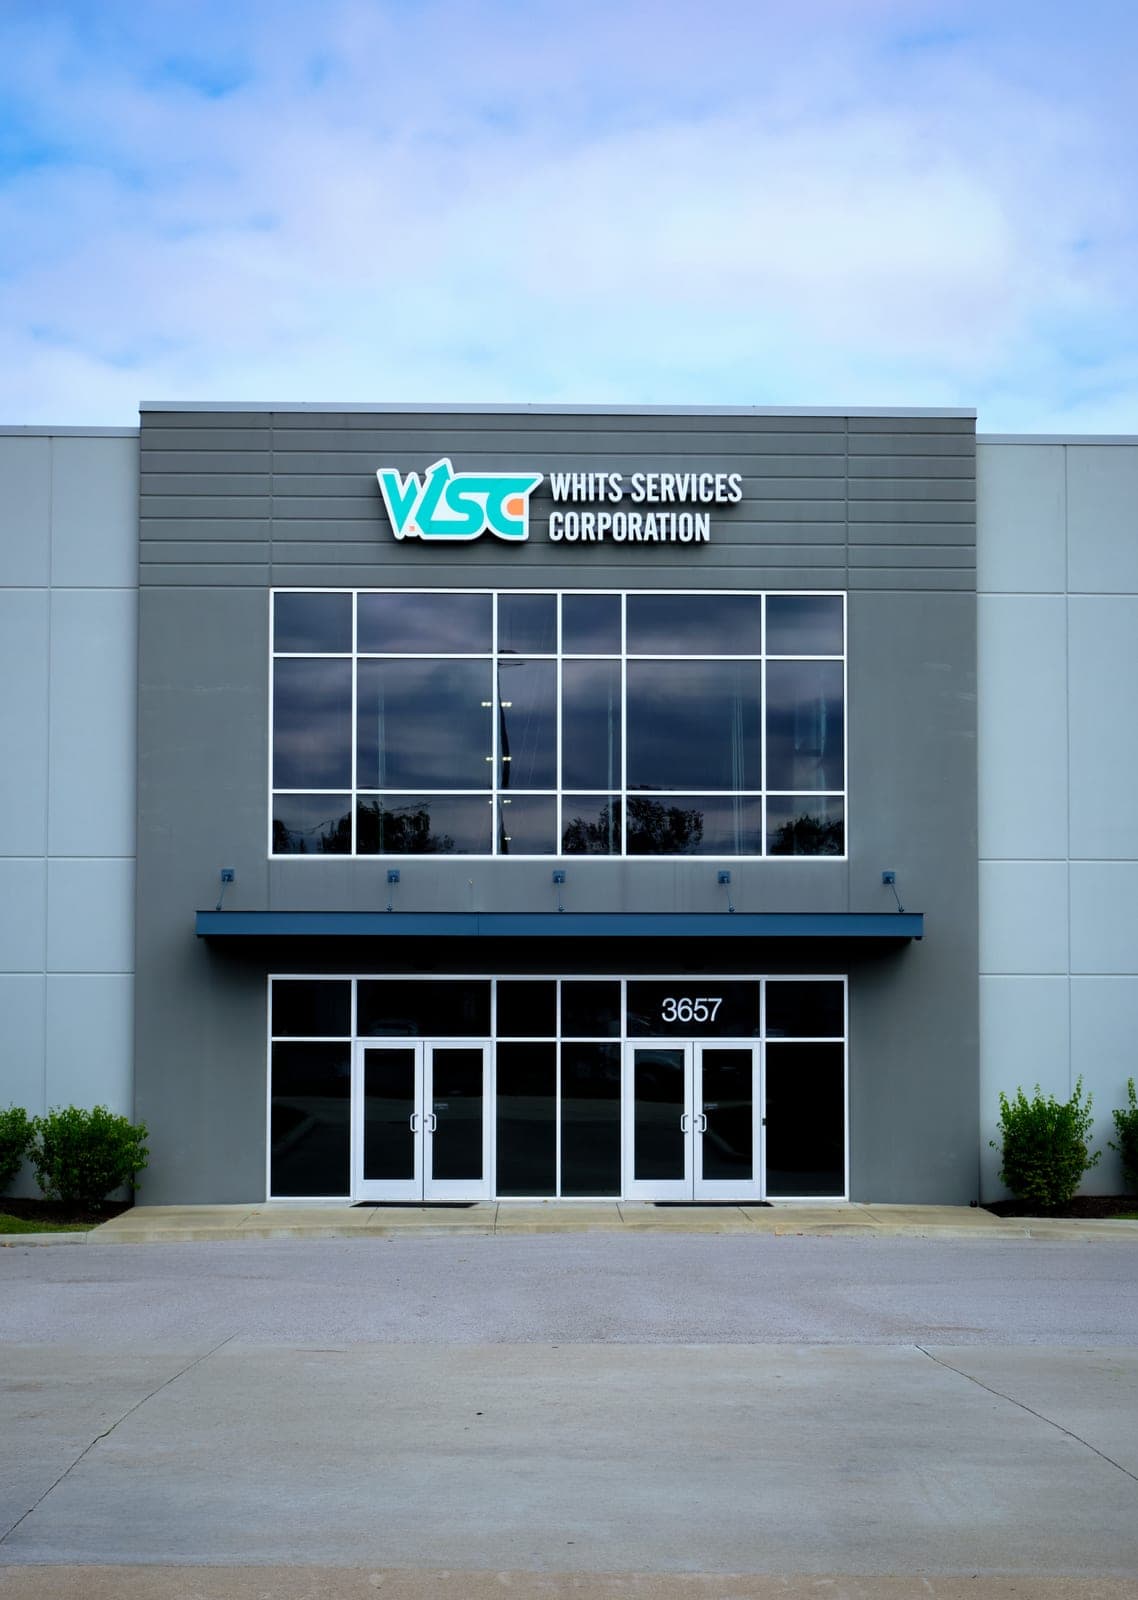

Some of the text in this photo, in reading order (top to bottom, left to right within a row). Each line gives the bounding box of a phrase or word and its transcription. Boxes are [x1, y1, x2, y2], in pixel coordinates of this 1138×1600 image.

[550, 472, 742, 502] WHITS SERVICES
[550, 511, 711, 542] CORPORATION
[661, 997, 723, 1022] 3657
